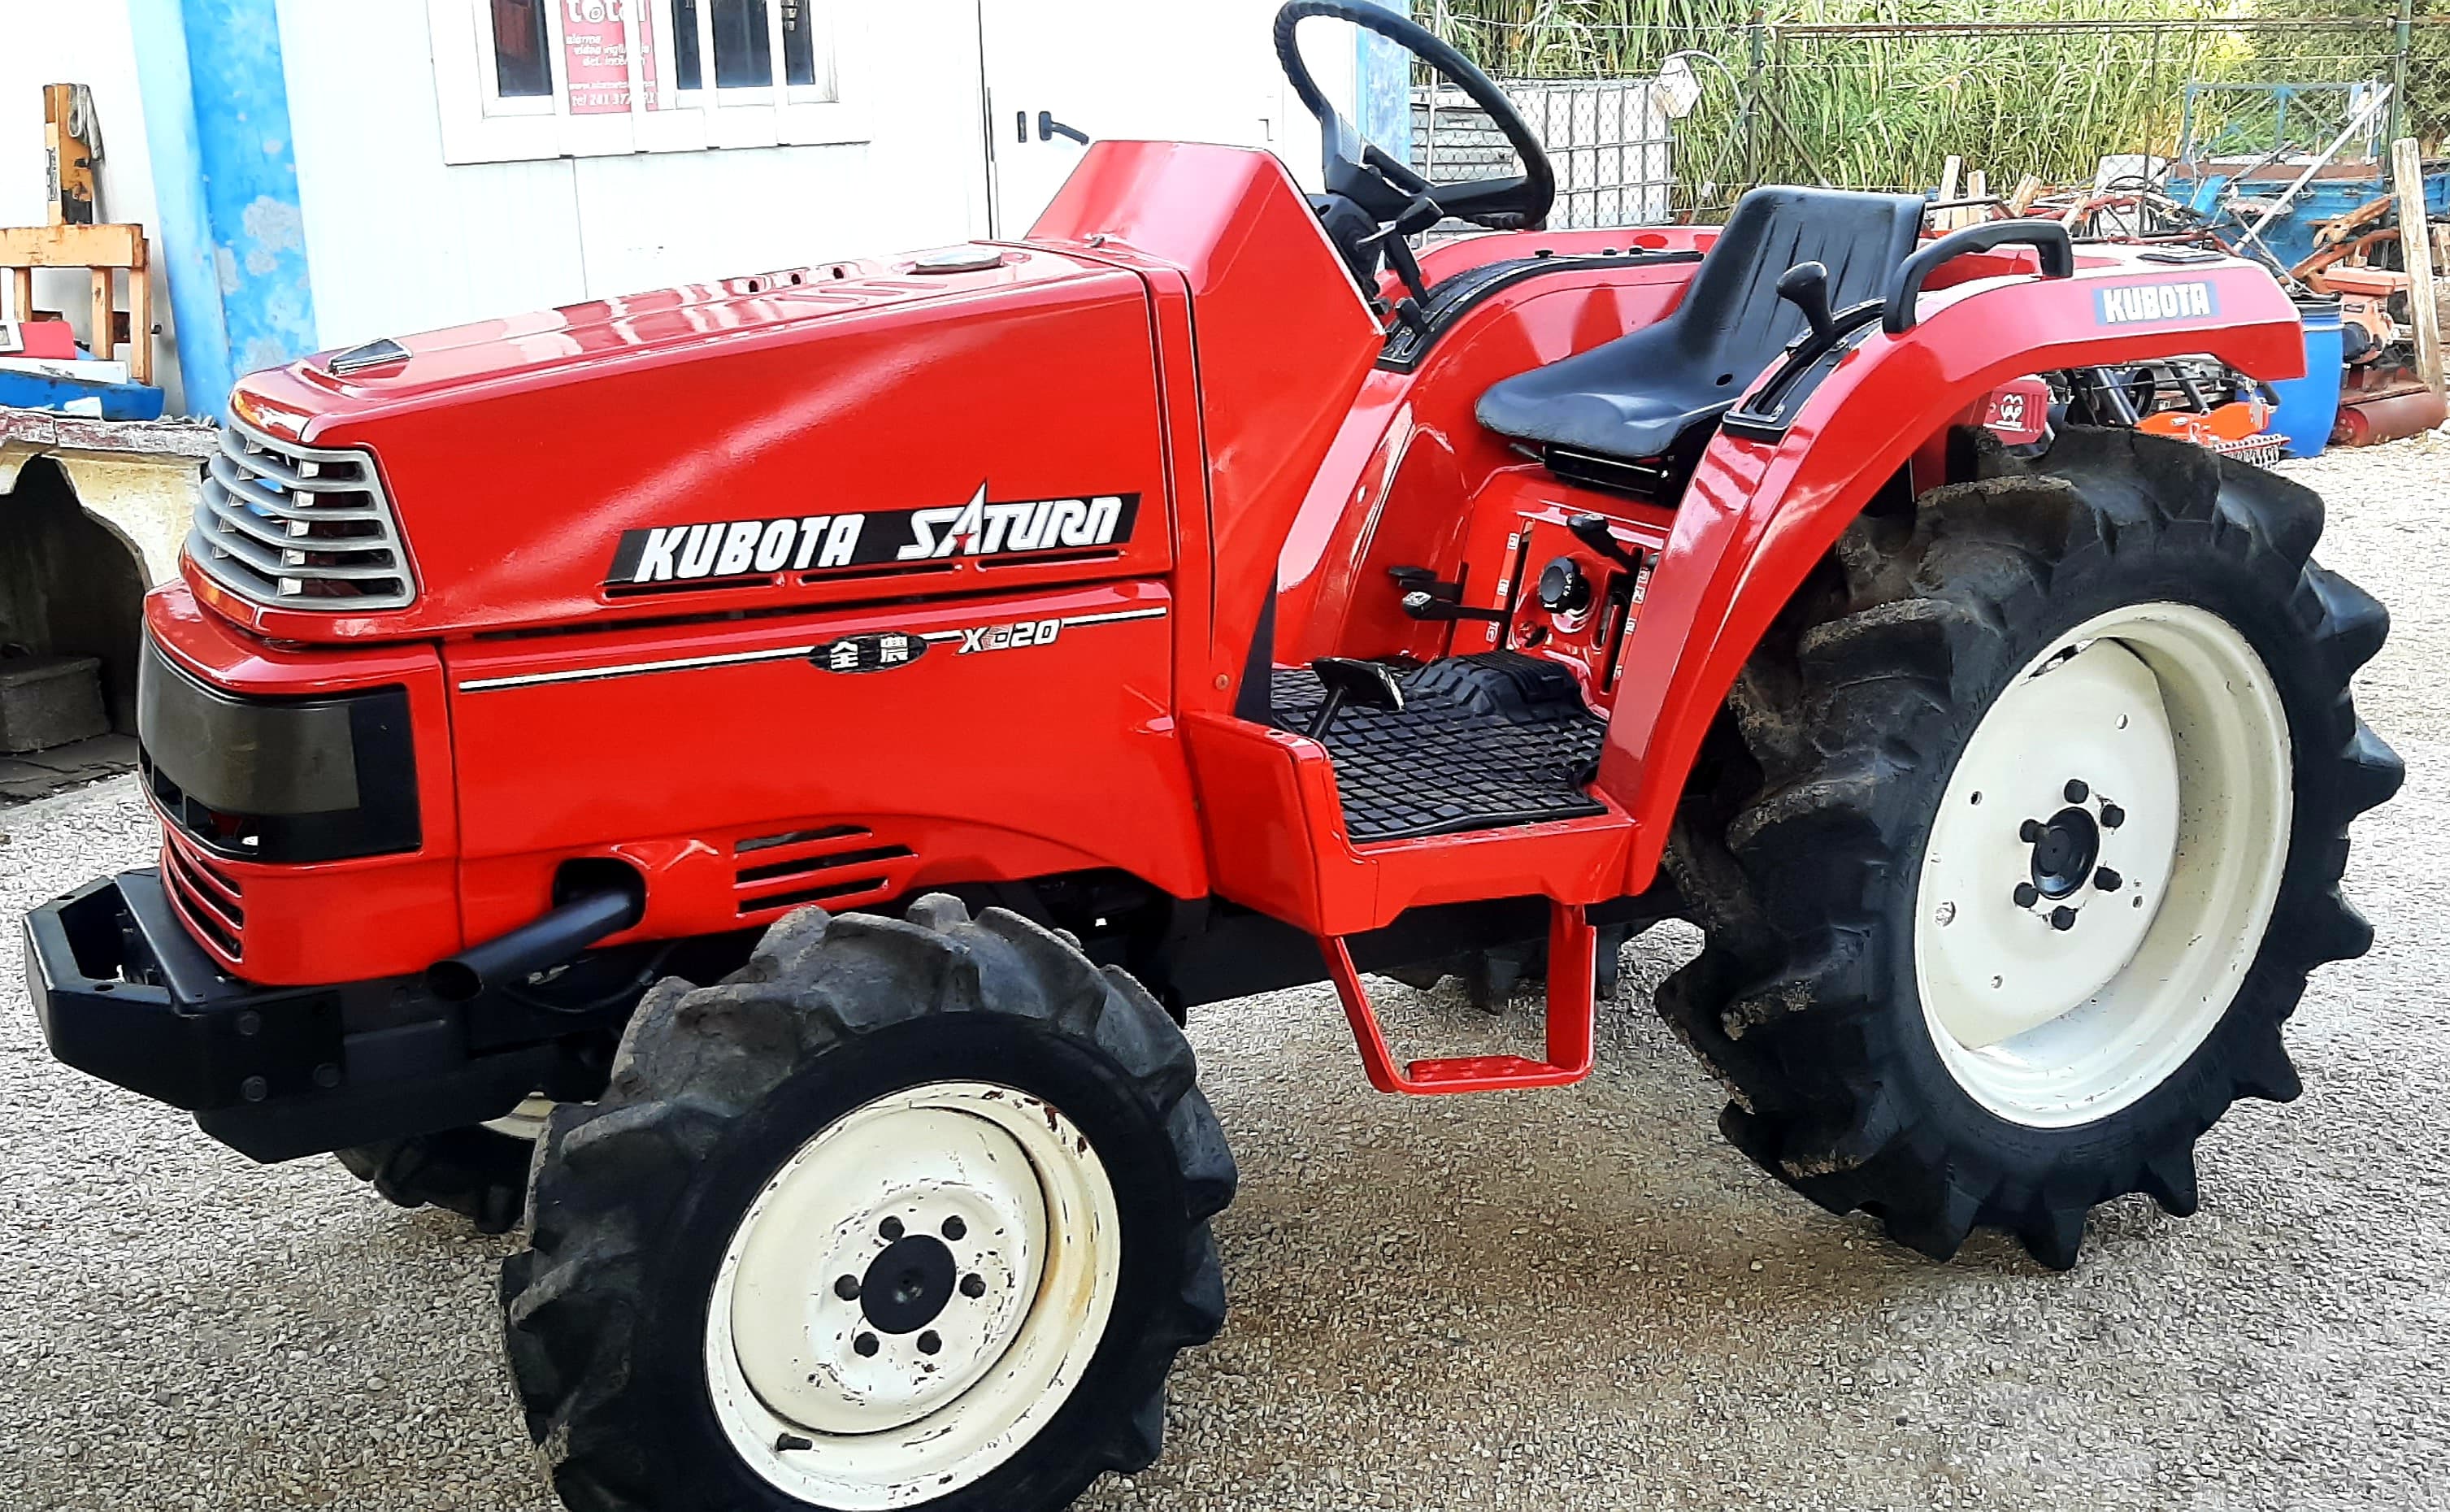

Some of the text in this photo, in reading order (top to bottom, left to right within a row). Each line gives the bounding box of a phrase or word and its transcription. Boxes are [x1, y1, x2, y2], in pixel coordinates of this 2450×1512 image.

[2103, 282, 2211, 324] KUBOTA
[633, 481, 1123, 583] KUBOTA SATURN
